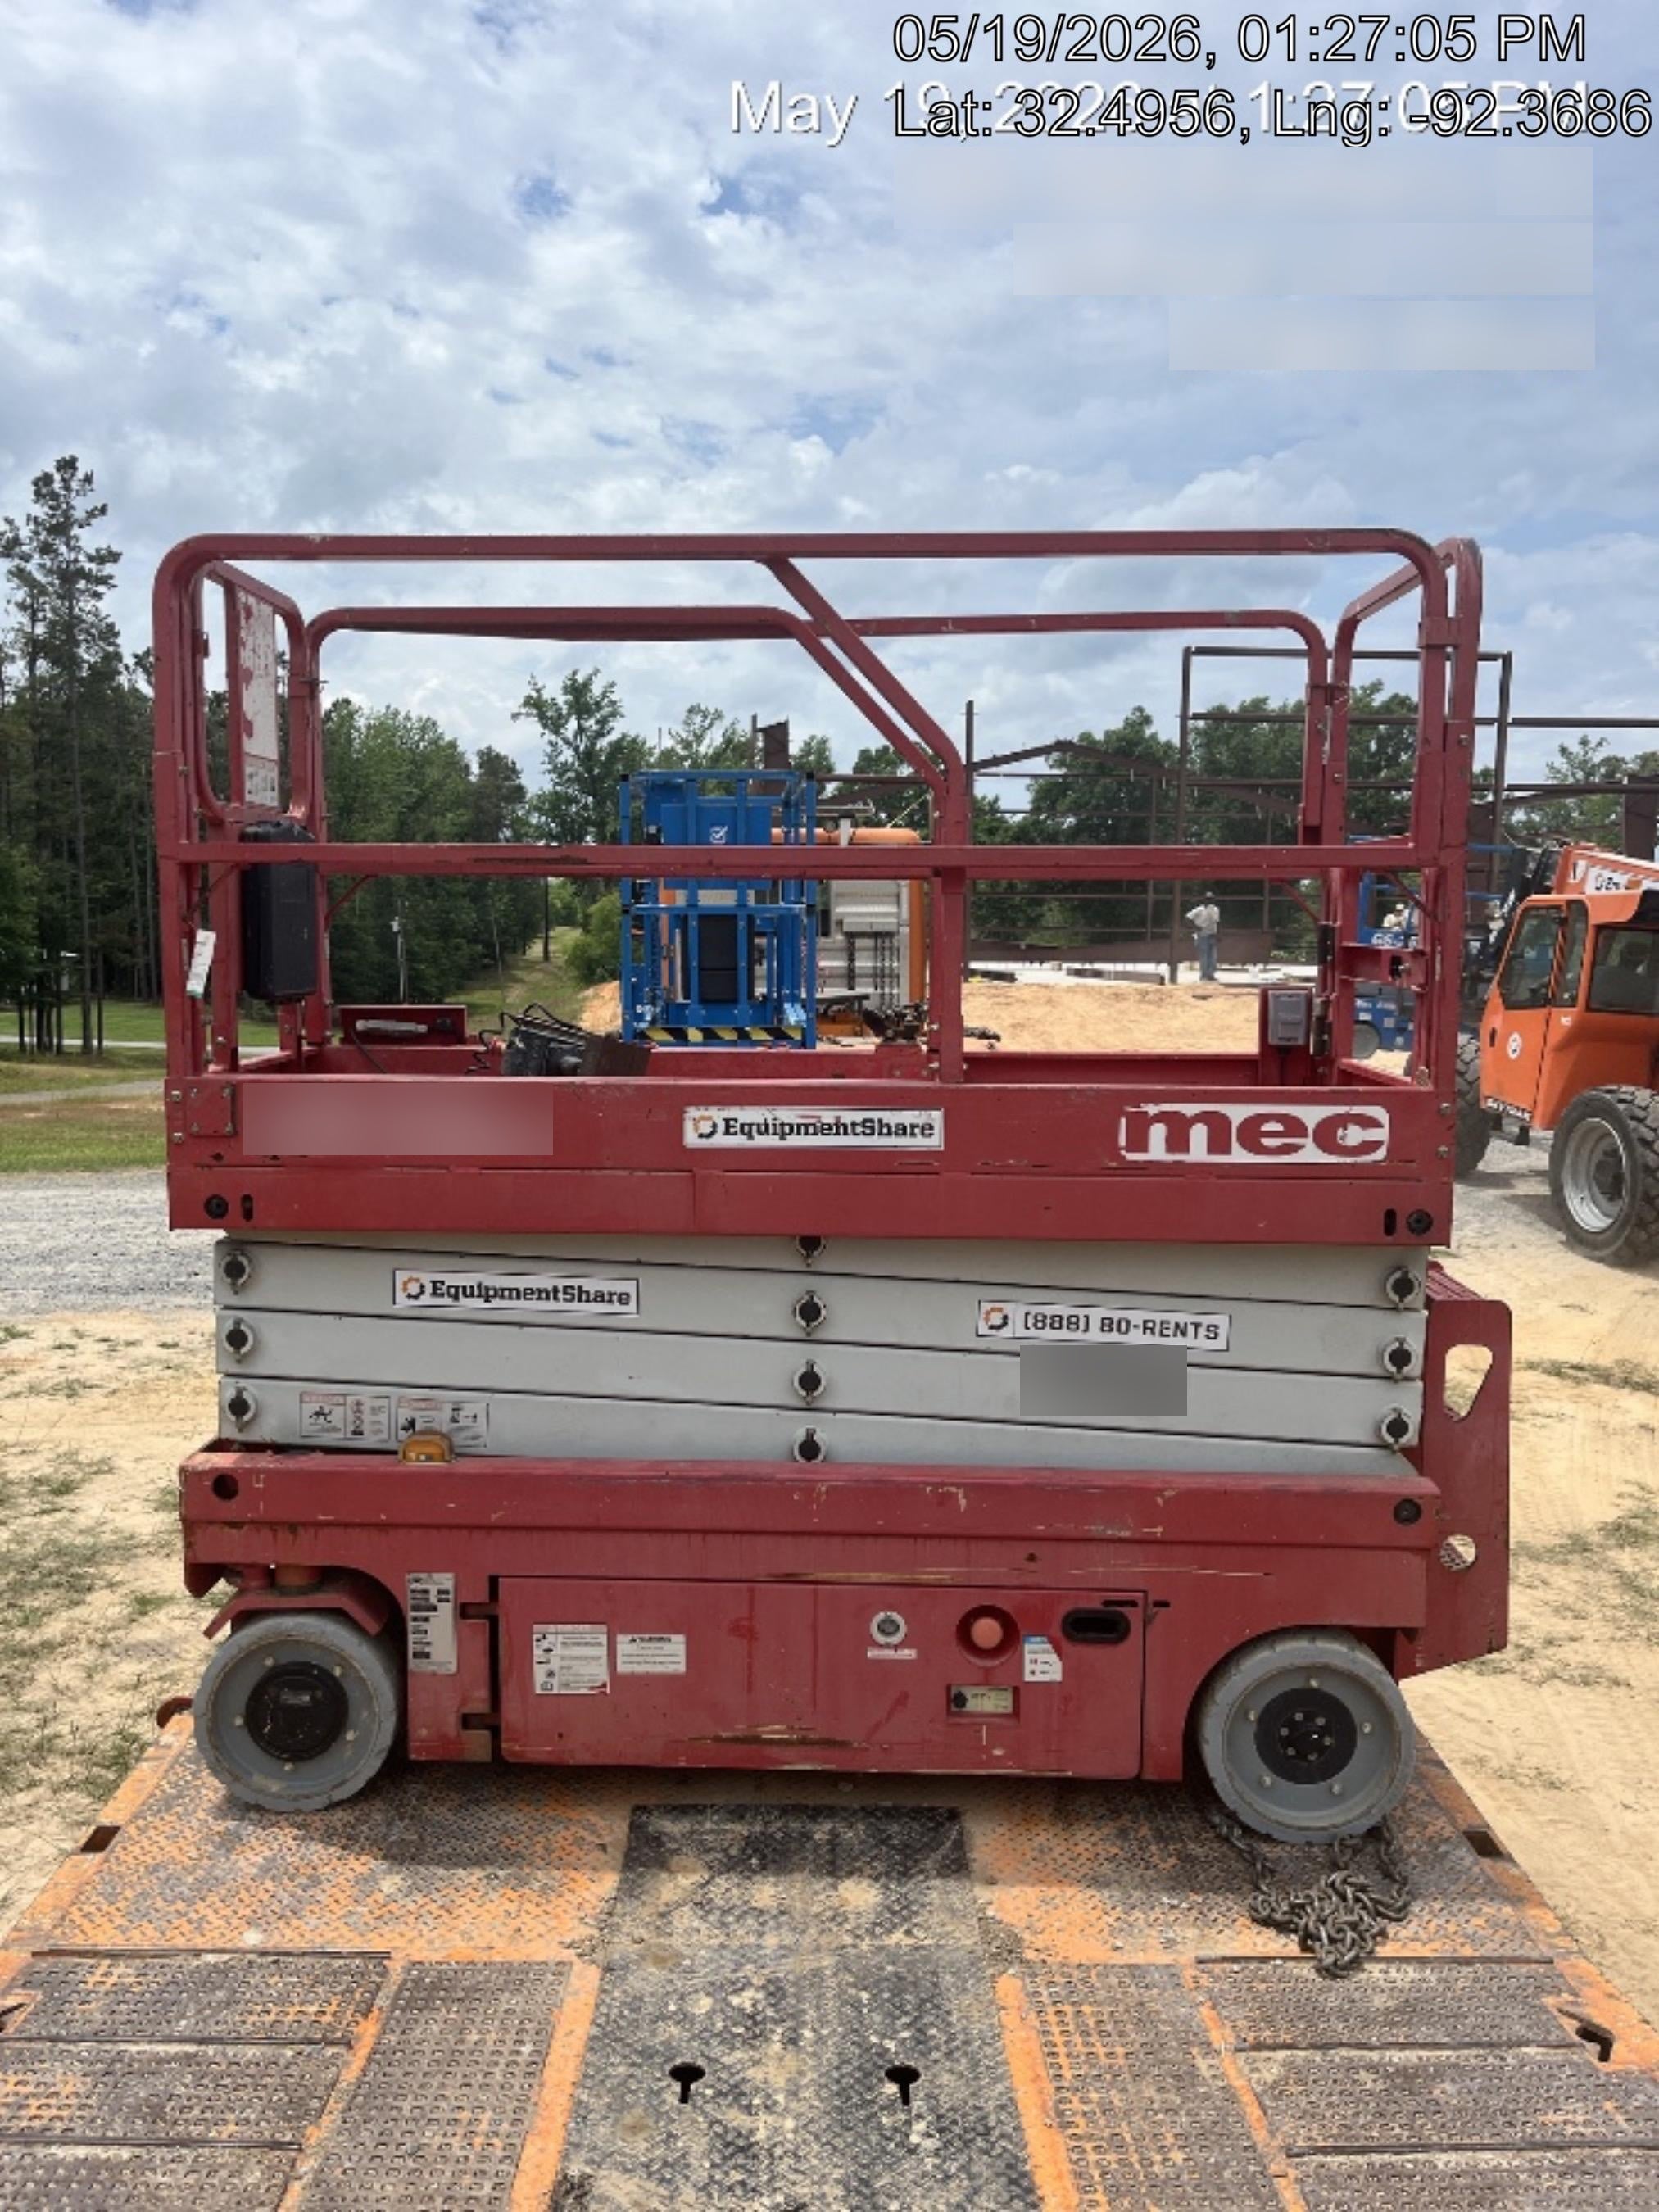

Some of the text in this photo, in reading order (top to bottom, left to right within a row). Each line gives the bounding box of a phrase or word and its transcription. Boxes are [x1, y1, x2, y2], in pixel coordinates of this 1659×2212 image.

[722, 1117, 935, 1141] EquipmentShare
[1126, 1110, 1385, 1158] mec
[428, 1280, 631, 1307] EquipmentShare
